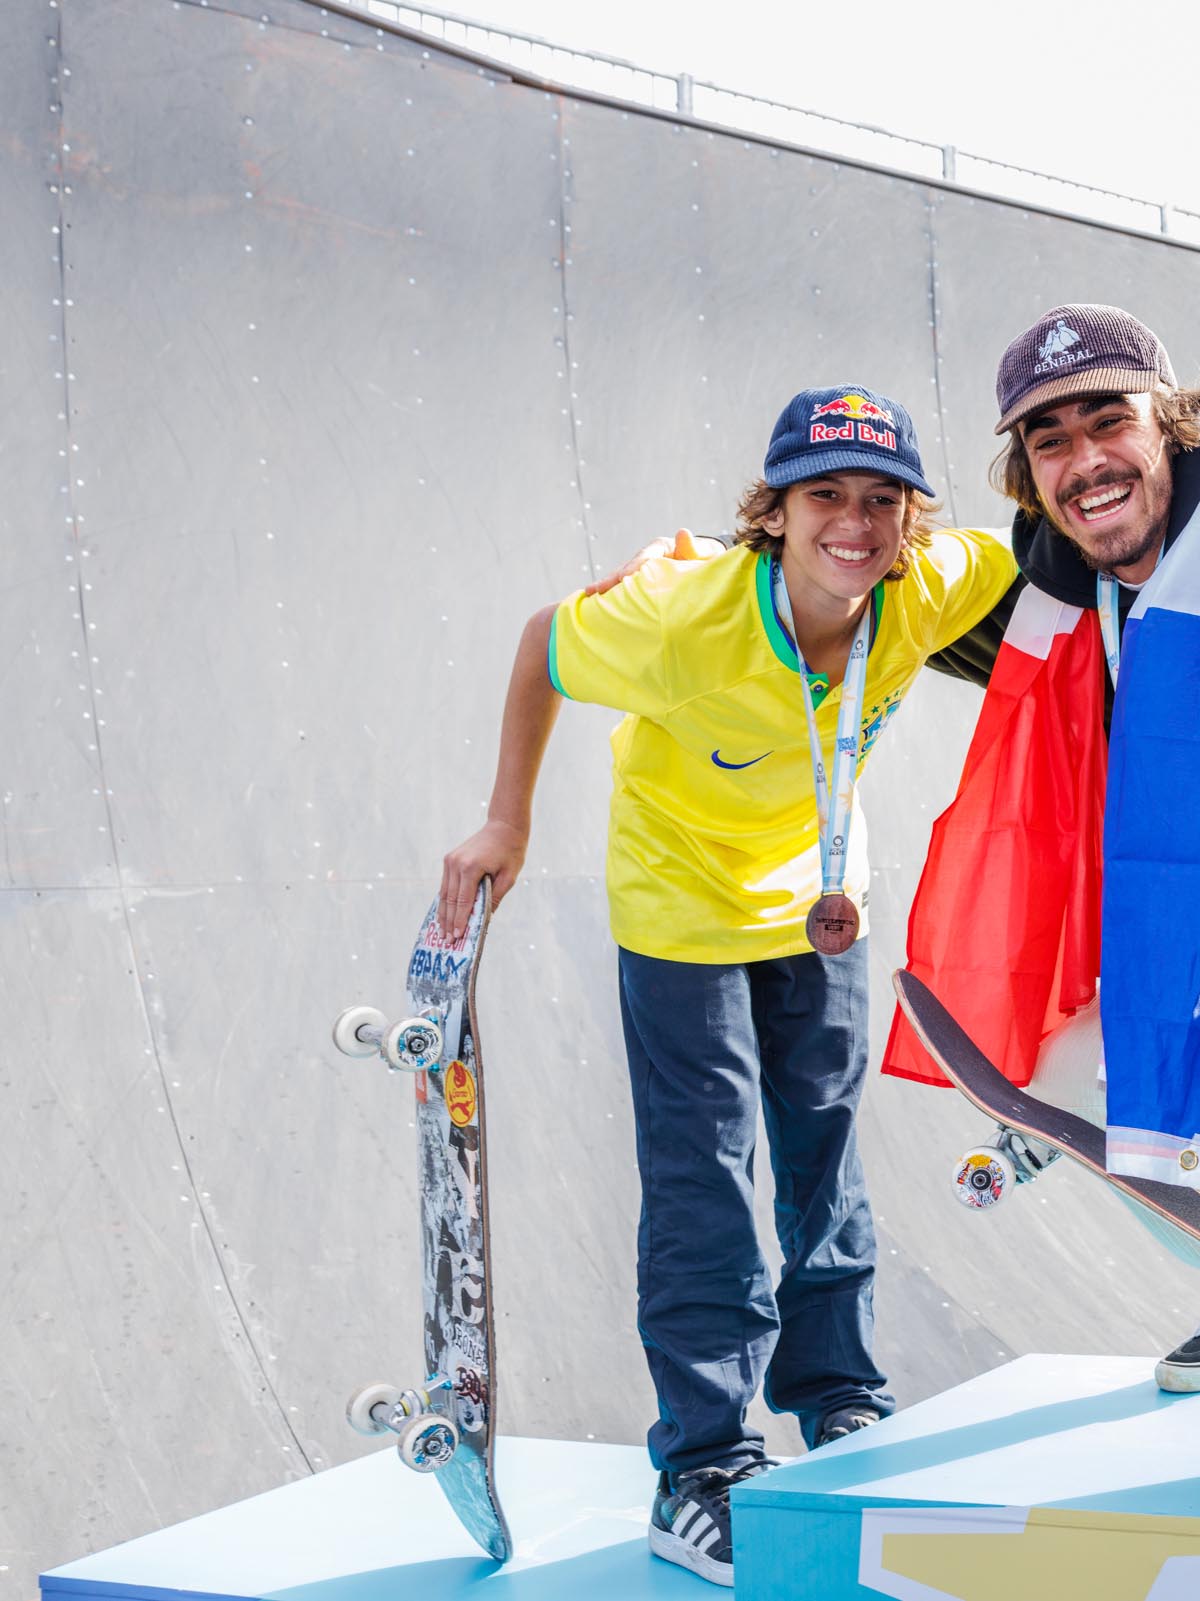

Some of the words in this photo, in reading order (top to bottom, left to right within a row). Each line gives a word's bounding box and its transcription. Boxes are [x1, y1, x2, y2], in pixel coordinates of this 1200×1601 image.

[1034, 348, 1094, 375] GENERAL
[810, 421, 854, 444] Red
[858, 422, 897, 451] Bull
